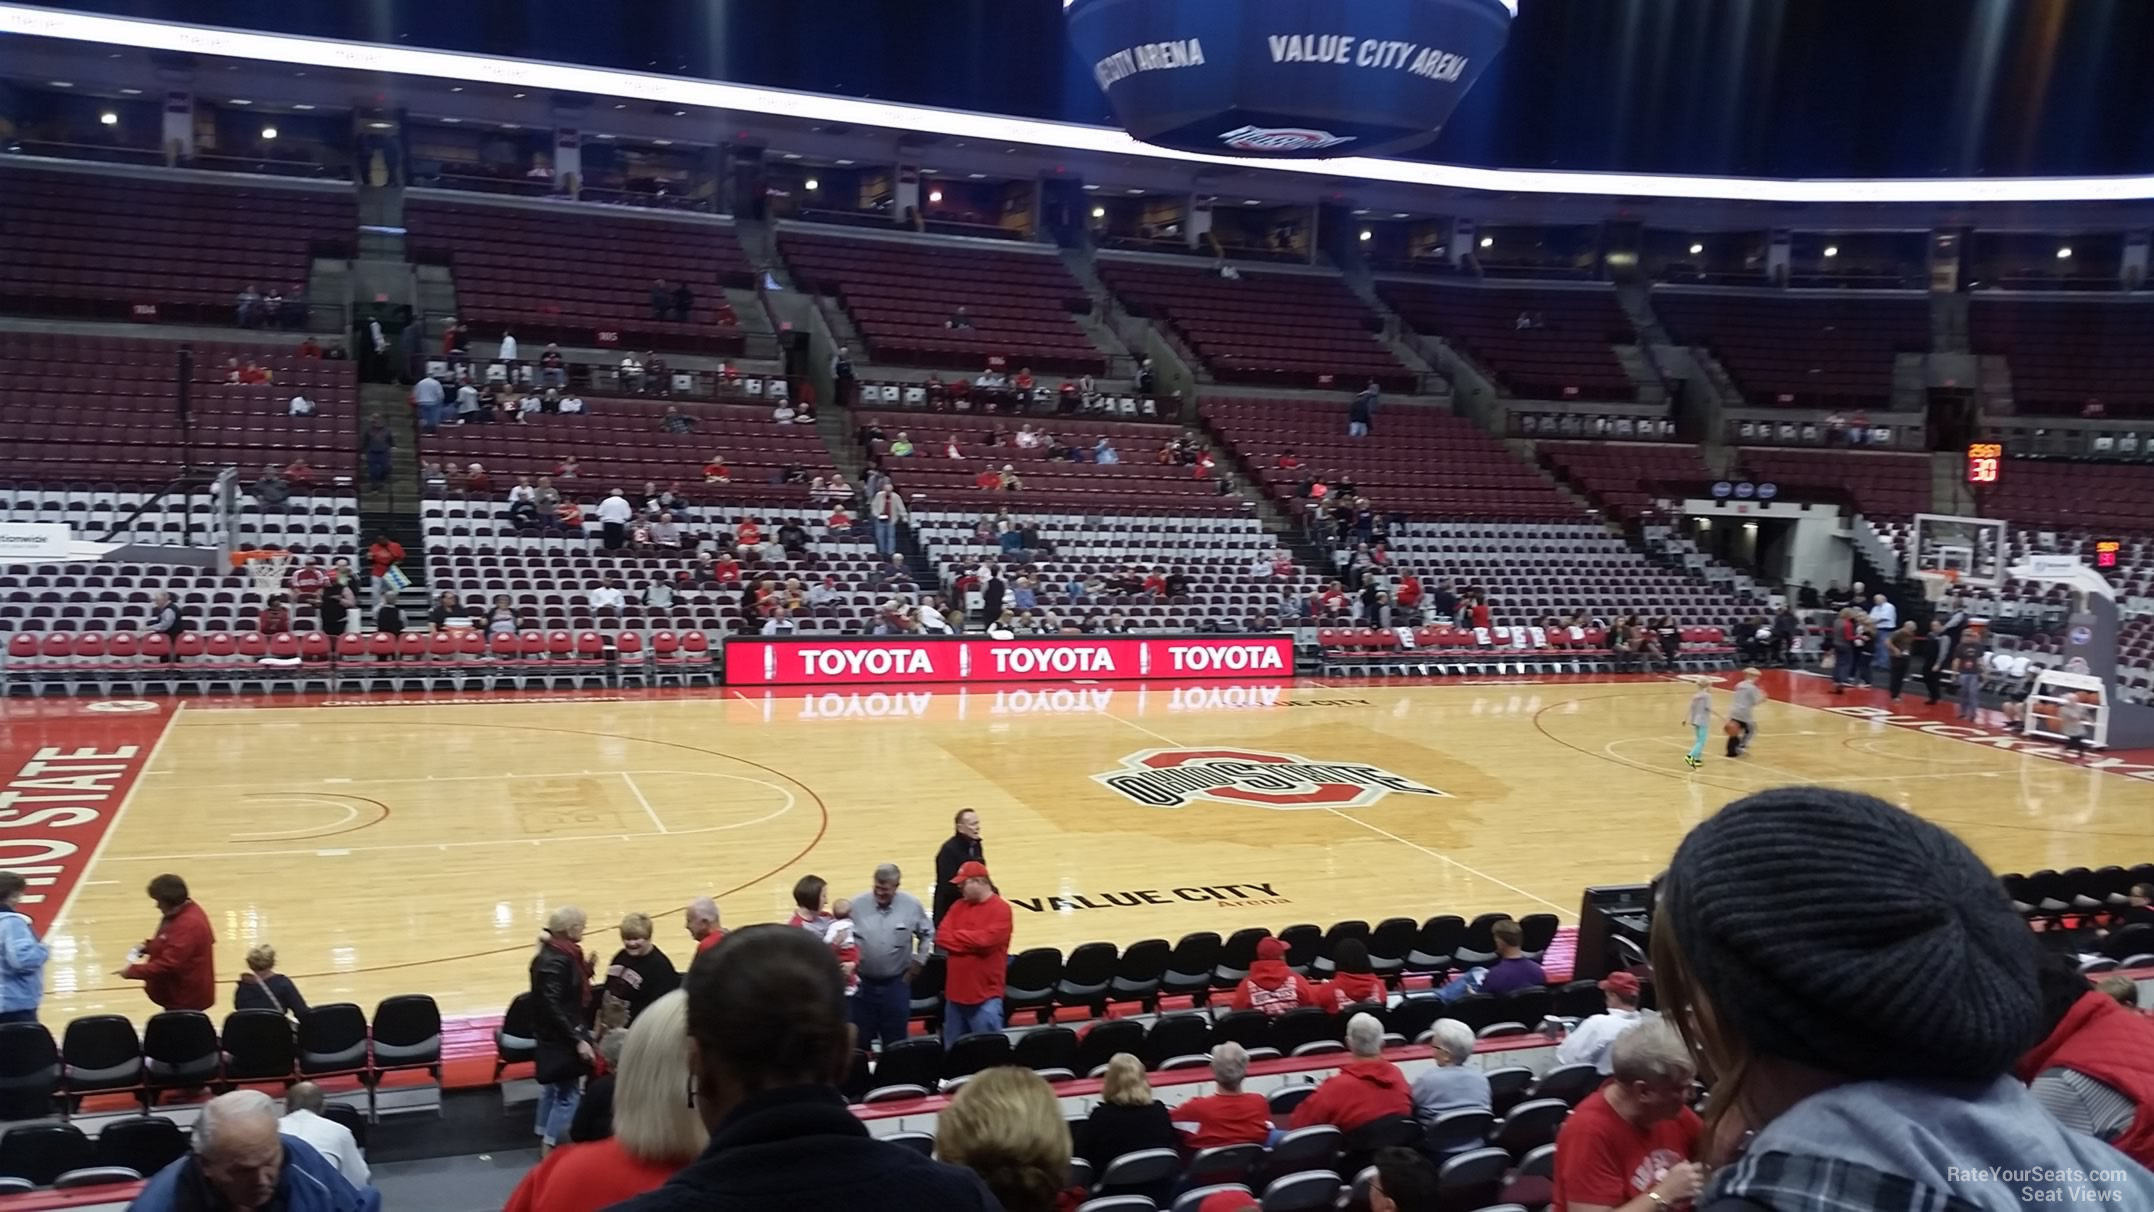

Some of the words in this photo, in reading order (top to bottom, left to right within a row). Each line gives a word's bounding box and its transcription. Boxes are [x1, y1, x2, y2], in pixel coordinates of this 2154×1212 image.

[1134, 38, 1205, 72] ARENA
[1268, 34, 1355, 64] VALUE
[1356, 39, 1417, 69] CITY
[1407, 47, 1469, 83] ARENA
[1972, 459, 1997, 481] 30
[799, 648, 933, 675] TOYOTA
[991, 647, 1115, 673] TOYOTA
[1168, 645, 1283, 670] TOYOTA
[0, 745, 140, 828] STATE
[1106, 762, 1238, 807] OHIO
[1008, 889, 1174, 912] VALUE
[1173, 883, 1281, 902] CITY
[1216, 896, 1291, 908] Arena
